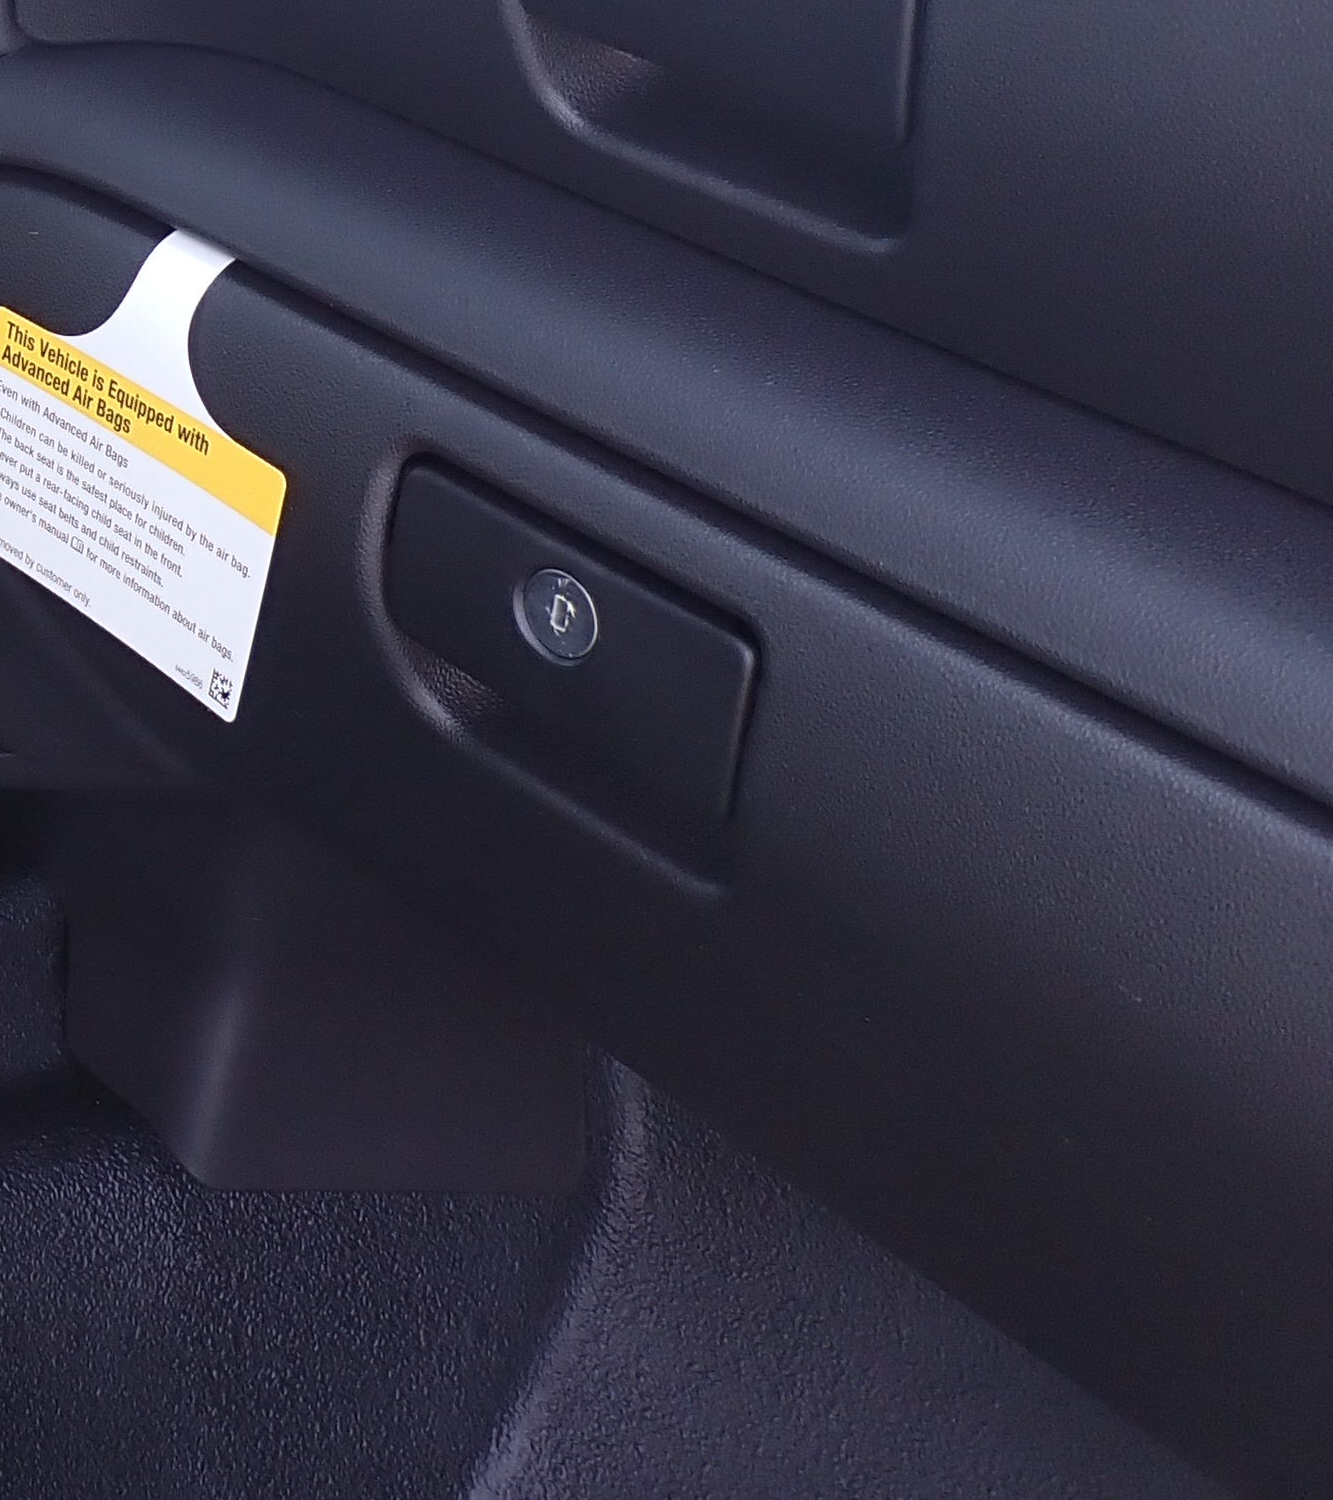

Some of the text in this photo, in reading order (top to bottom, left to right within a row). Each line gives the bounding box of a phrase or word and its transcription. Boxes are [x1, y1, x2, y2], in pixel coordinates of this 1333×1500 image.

[1, 344, 132, 434] Advanced Air Bags
[7, 320, 210, 456] This Vehicle is Equipped with
[20, 394, 41, 415] with
[42, 406, 88, 443] Advanced
[88, 434, 104, 452] Air
[104, 443, 129, 469] Bags
[0, 407, 37, 438] Children
[38, 432, 55, 450] can
[56, 440, 69, 457] be
[70, 449, 96, 474] killed
[96, 468, 108, 481] or
[108, 475, 150, 511] seriously
[151, 500, 184, 532] injured
[184, 523, 198, 542] by
[199, 533, 215, 552] the
[215, 547, 230, 562] air
[13, 436, 35, 459] back
[35, 452, 55, 471] seat
[56, 463, 65, 477] is
[65, 468, 80, 486] the
[80, 480, 108, 504] safest
[108, 498, 133, 521] place
[134, 512, 148, 529] for
[18, 462, 34, 479] put
[34, 472, 41, 483] a
[42, 477, 90, 517] rear-facing
[90, 508, 113, 529] child
[113, 523, 133, 543] seat
[133, 534, 143, 550] in
[144, 542, 159, 561] the
[21, 485, 37, 502] use
[38, 496, 57, 515] seat
[58, 506, 80, 530] belts
[80, 524, 98, 542] and
[98, 535, 121, 557] child
[24, 552, 36, 570] by
[35, 562, 73, 594] customer
[38, 517, 70, 545] manual
[85, 547, 99, 564] for
[99, 558, 121, 580] more
[122, 572, 171, 615] information
[171, 609, 197, 635] about
[197, 628, 211, 644] air
